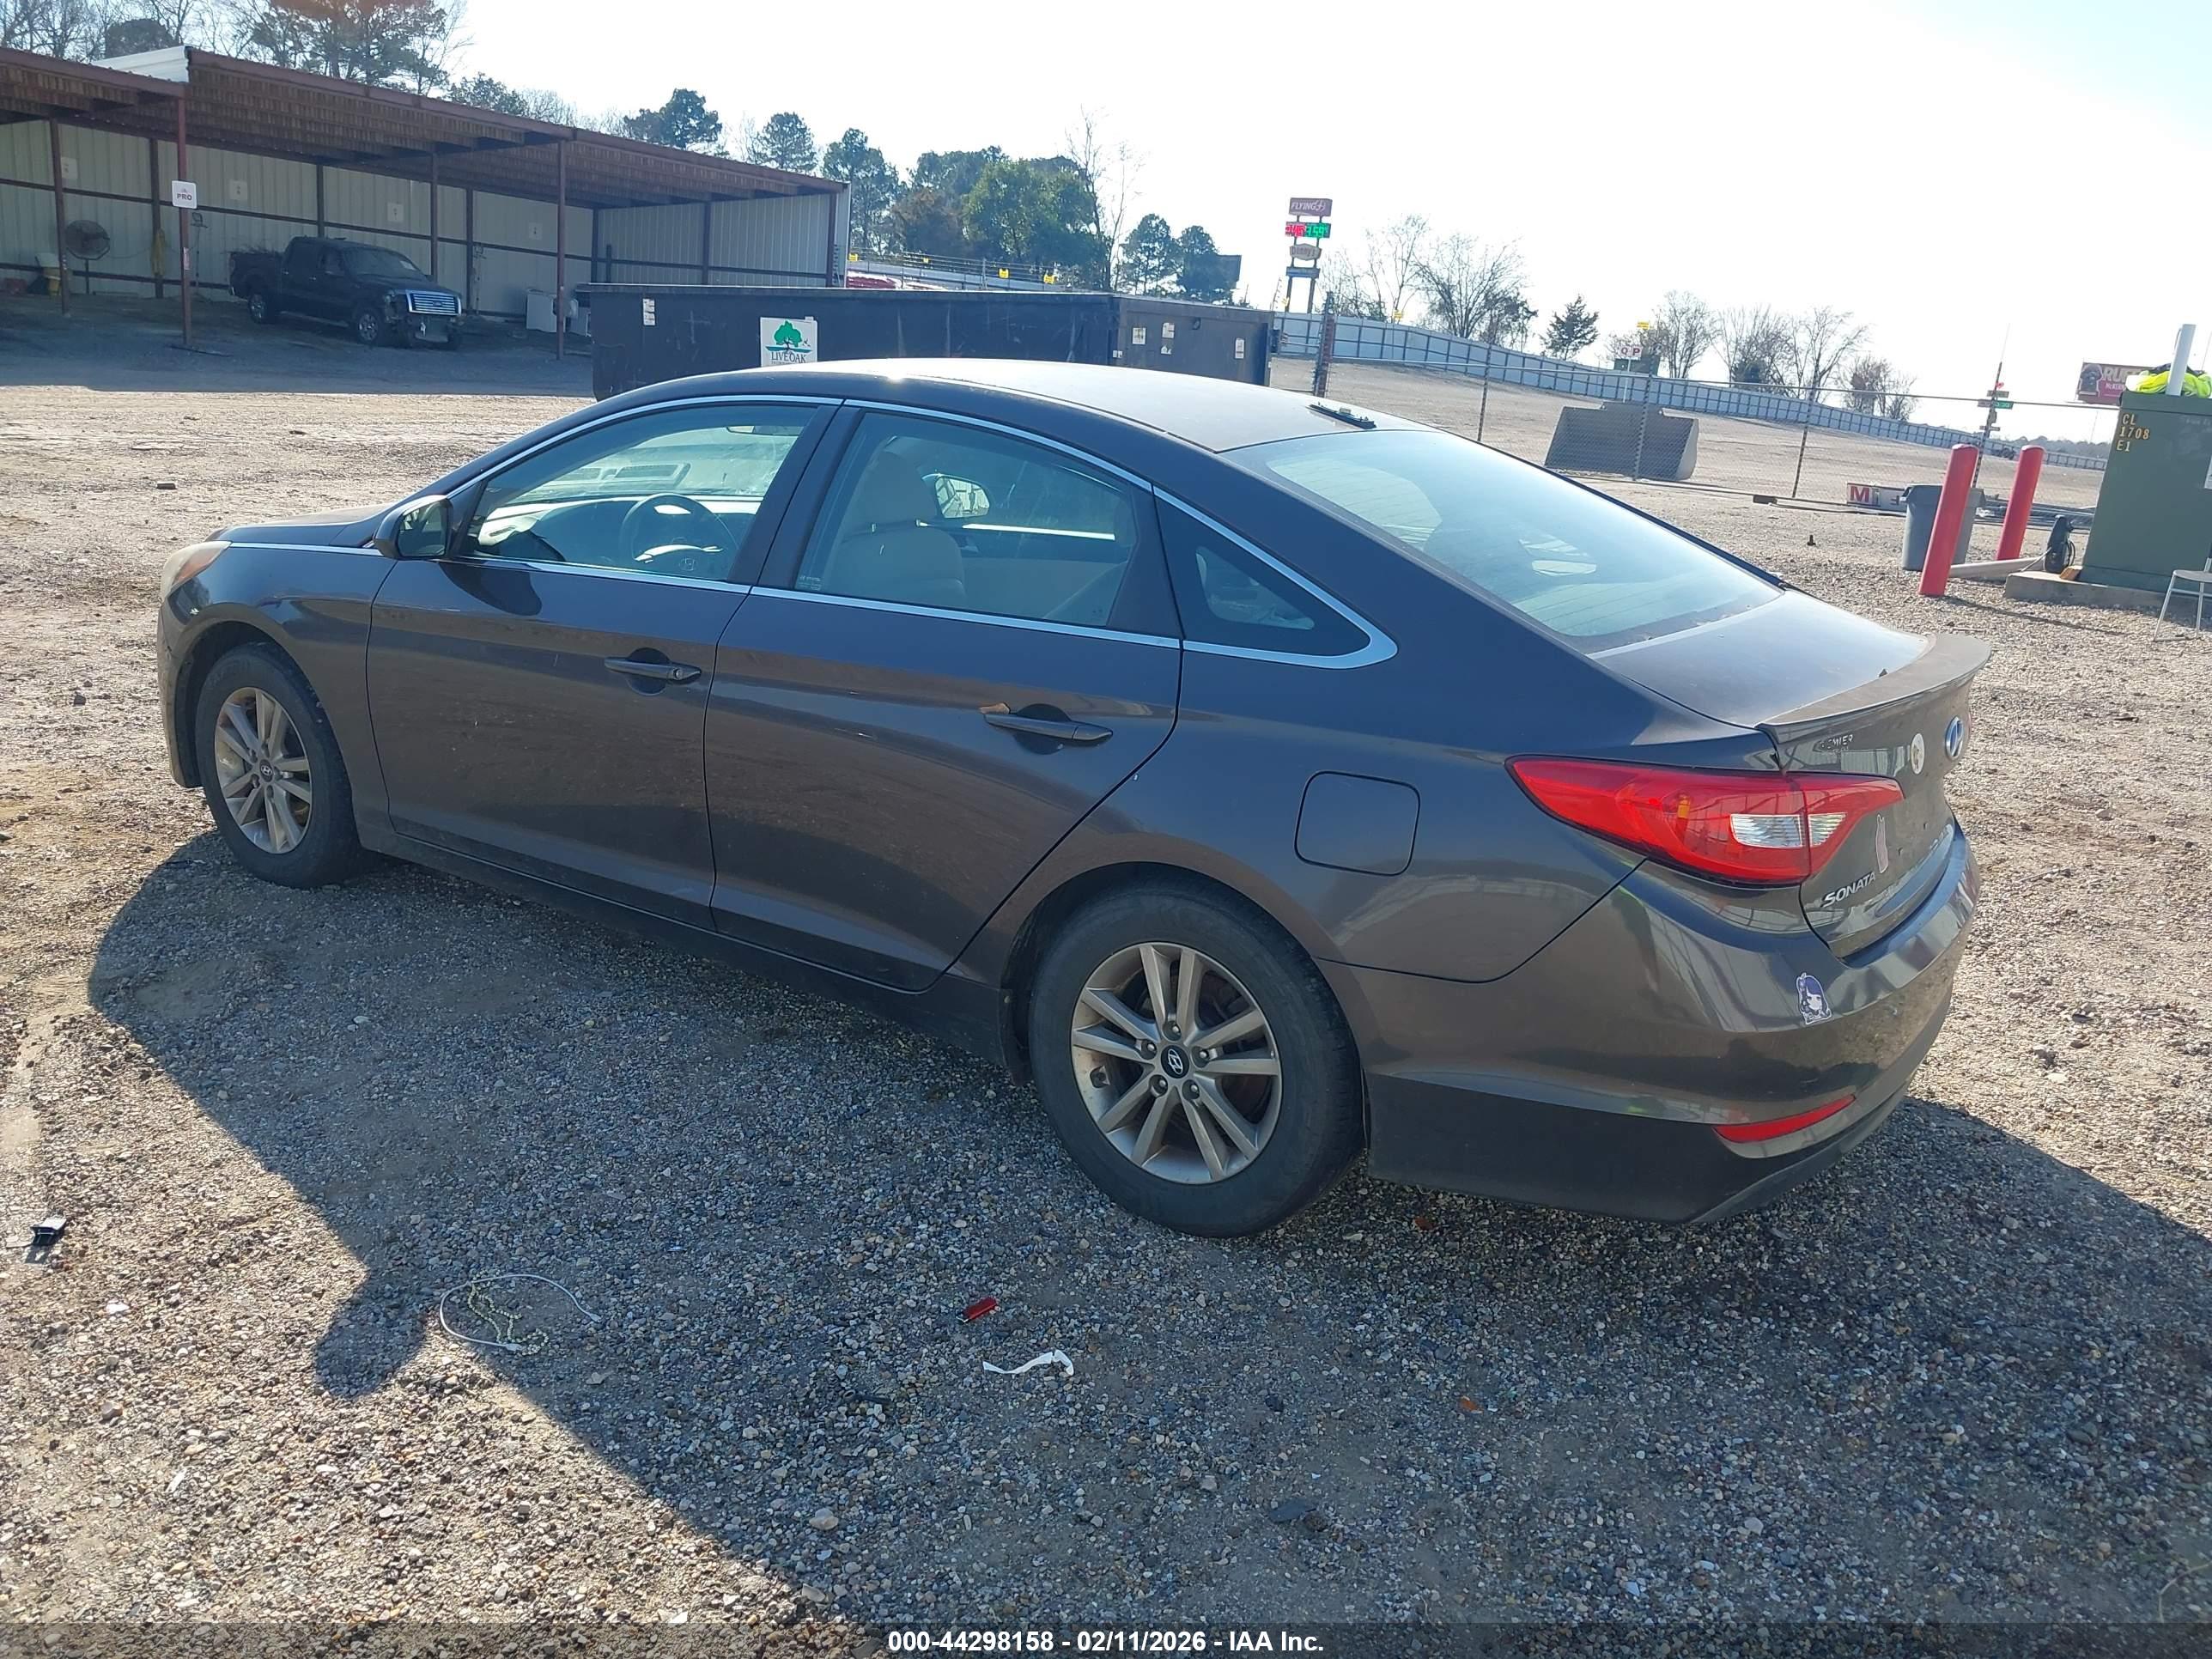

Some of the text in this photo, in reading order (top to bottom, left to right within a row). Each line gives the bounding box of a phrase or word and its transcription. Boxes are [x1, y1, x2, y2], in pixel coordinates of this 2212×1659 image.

[1632, 348, 1640, 356] P
[2122, 414, 2136, 426] CL
[2119, 426, 2150, 440] 1708
[2117, 440, 2131, 452] E1
[1821, 871, 1876, 908] SONATA
